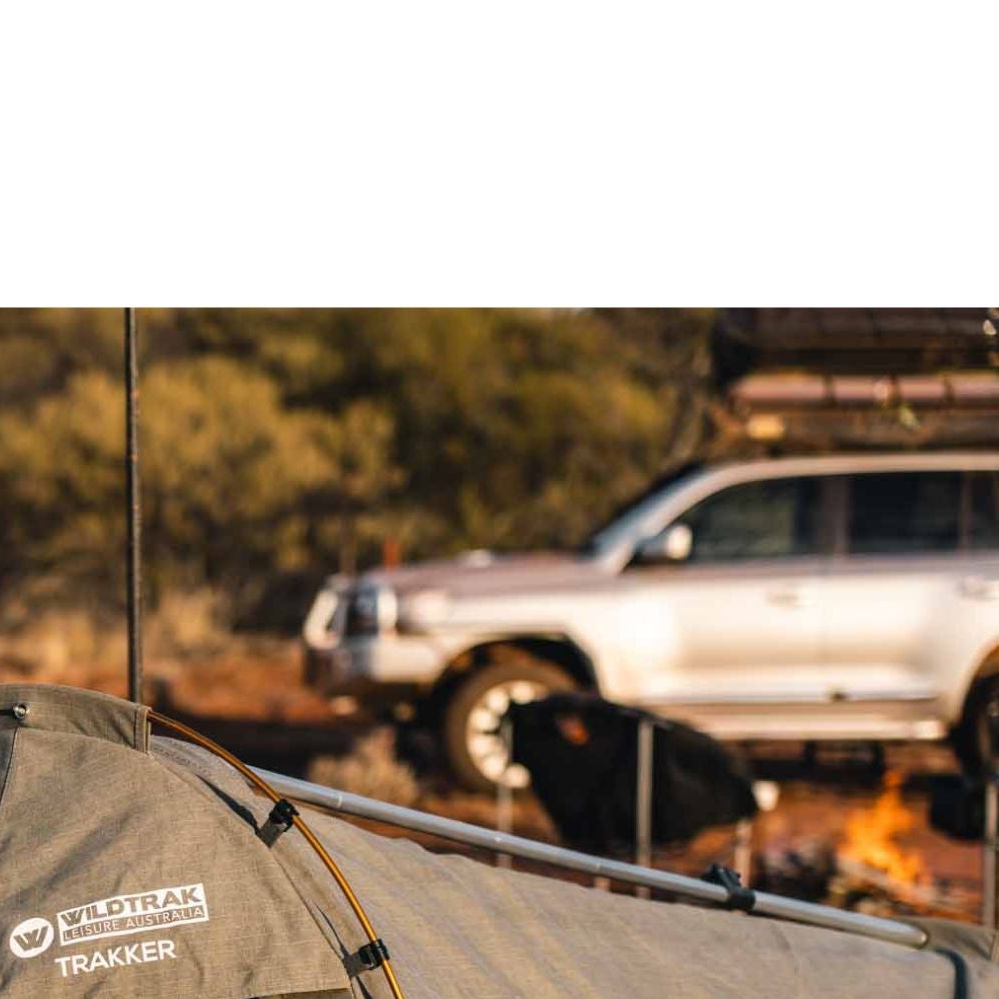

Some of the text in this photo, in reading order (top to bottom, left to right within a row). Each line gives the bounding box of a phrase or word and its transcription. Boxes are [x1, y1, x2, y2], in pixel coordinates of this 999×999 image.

[60, 886, 203, 927] WILDTRAK
[63, 906, 204, 940] LEISURE AUSTRALIA
[54, 939, 177, 978] TRAKKER
